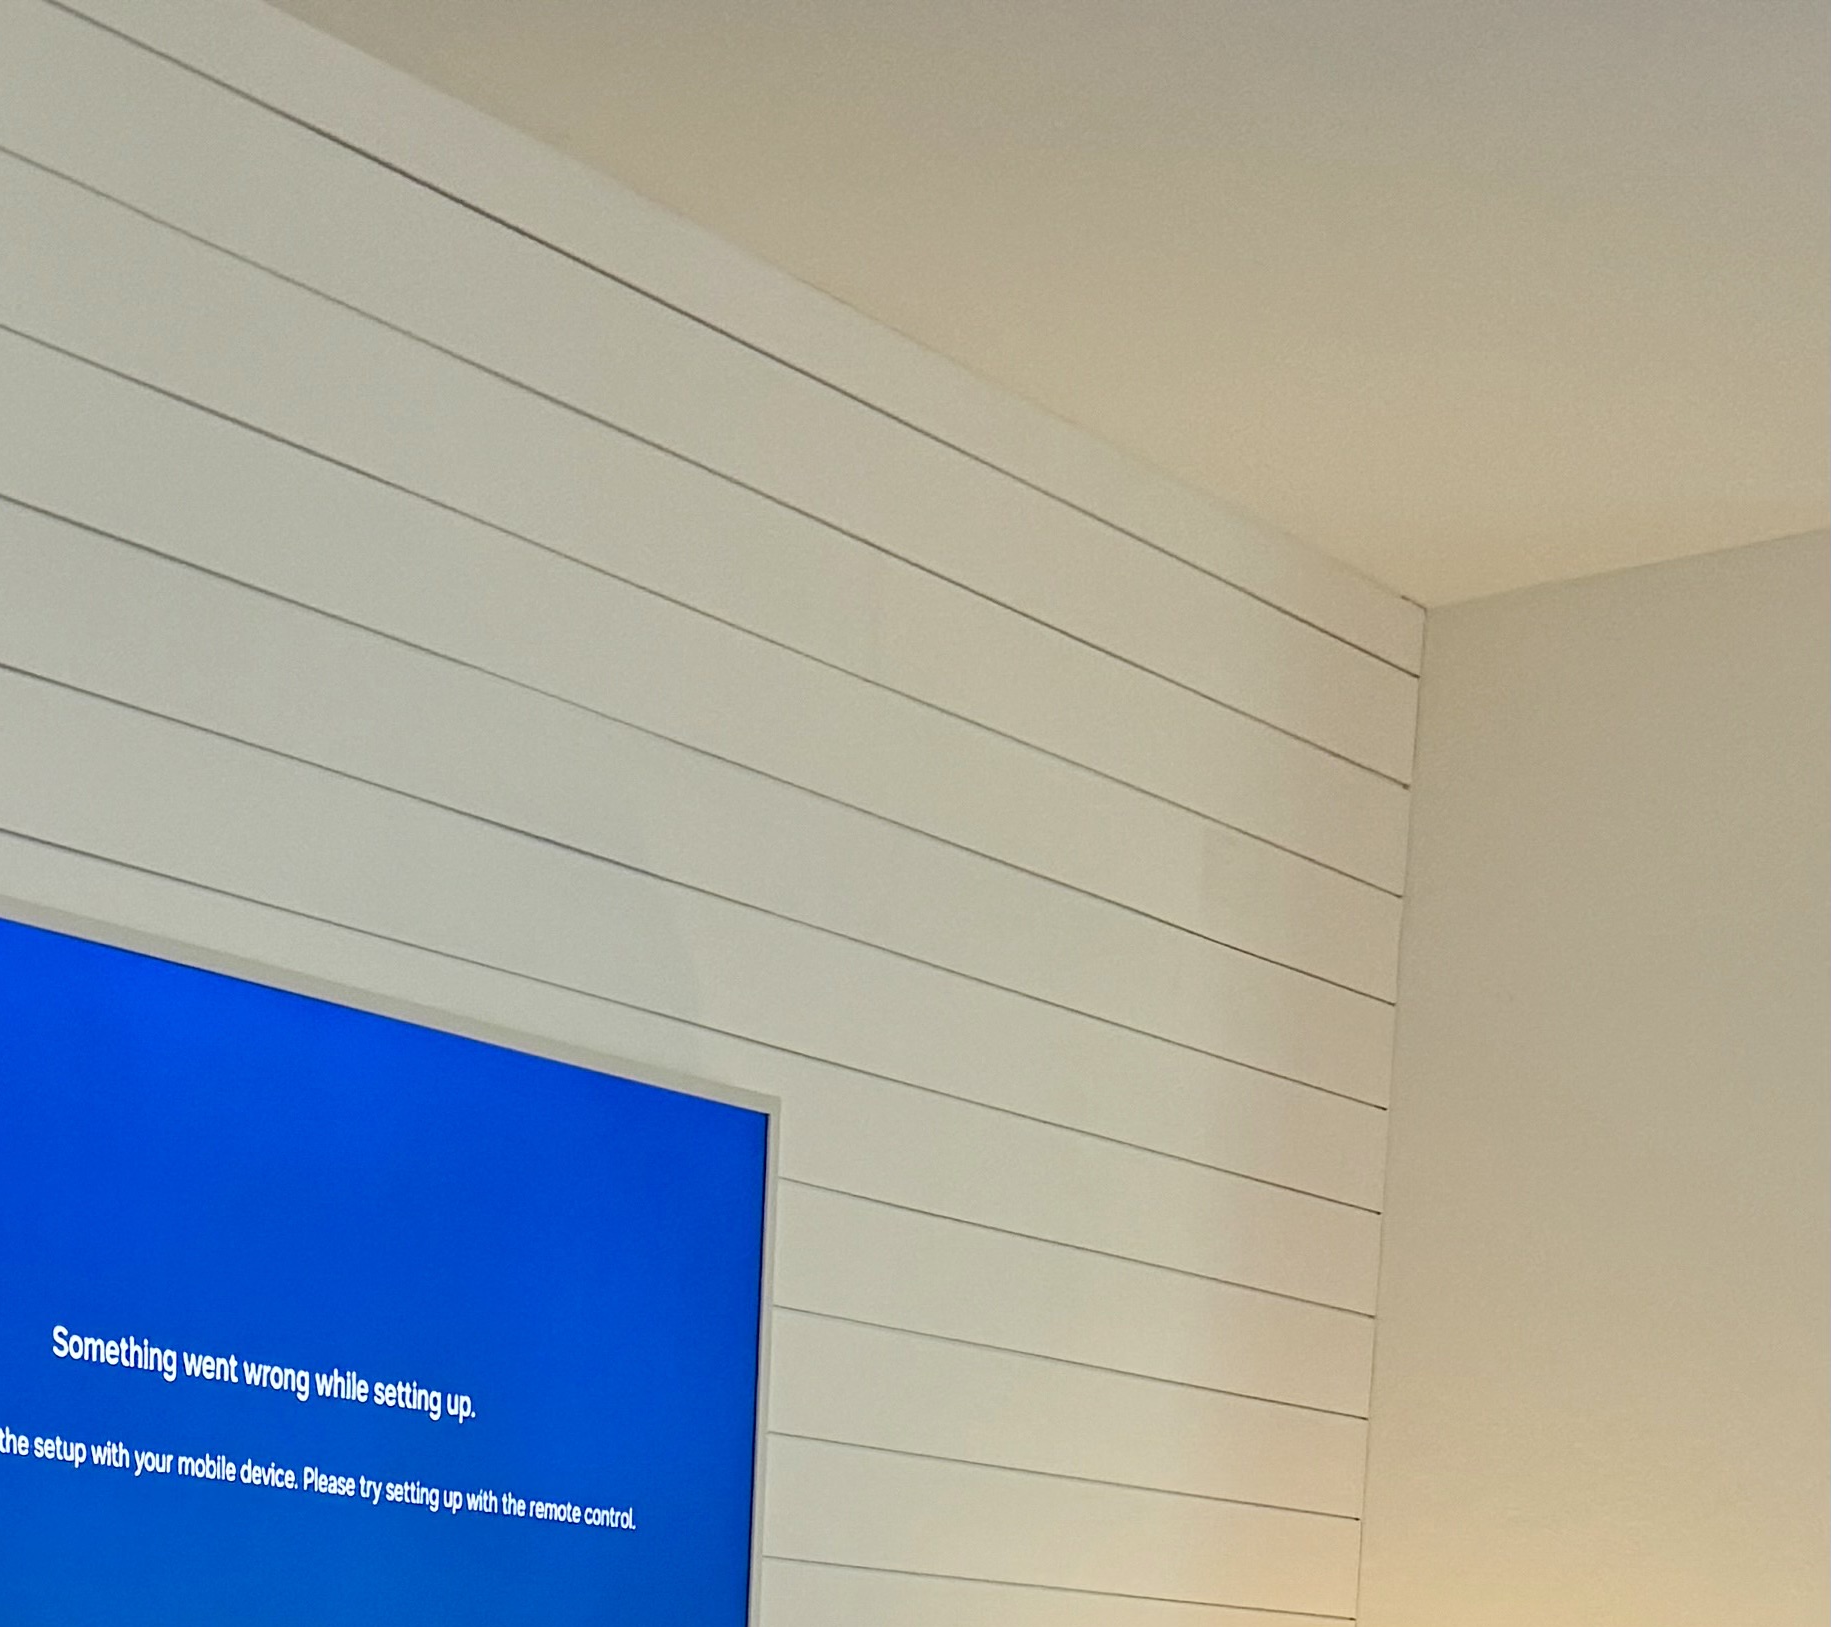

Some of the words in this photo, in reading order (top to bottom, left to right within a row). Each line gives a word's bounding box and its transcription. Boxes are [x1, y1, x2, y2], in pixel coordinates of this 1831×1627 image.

[52, 1325, 177, 1382] Something
[182, 1351, 239, 1383] went
[242, 1360, 310, 1402] wrong
[314, 1368, 370, 1403] while
[373, 1380, 442, 1421] setting
[446, 1393, 476, 1424] up.
[33, 1435, 87, 1469] setup
[90, 1440, 130, 1469] with
[134, 1450, 174, 1477] your
[177, 1453, 237, 1482] mobile
[239, 1458, 299, 1490] device.
[303, 1466, 356, 1497] Please
[359, 1475, 383, 1505] try
[385, 1480, 440, 1513] setting
[443, 1489, 463, 1515] up
[466, 1489, 498, 1514] with
[501, 1491, 527, 1517] the
[529, 1500, 582, 1524] remote
[583, 1506, 636, 1530] control.
